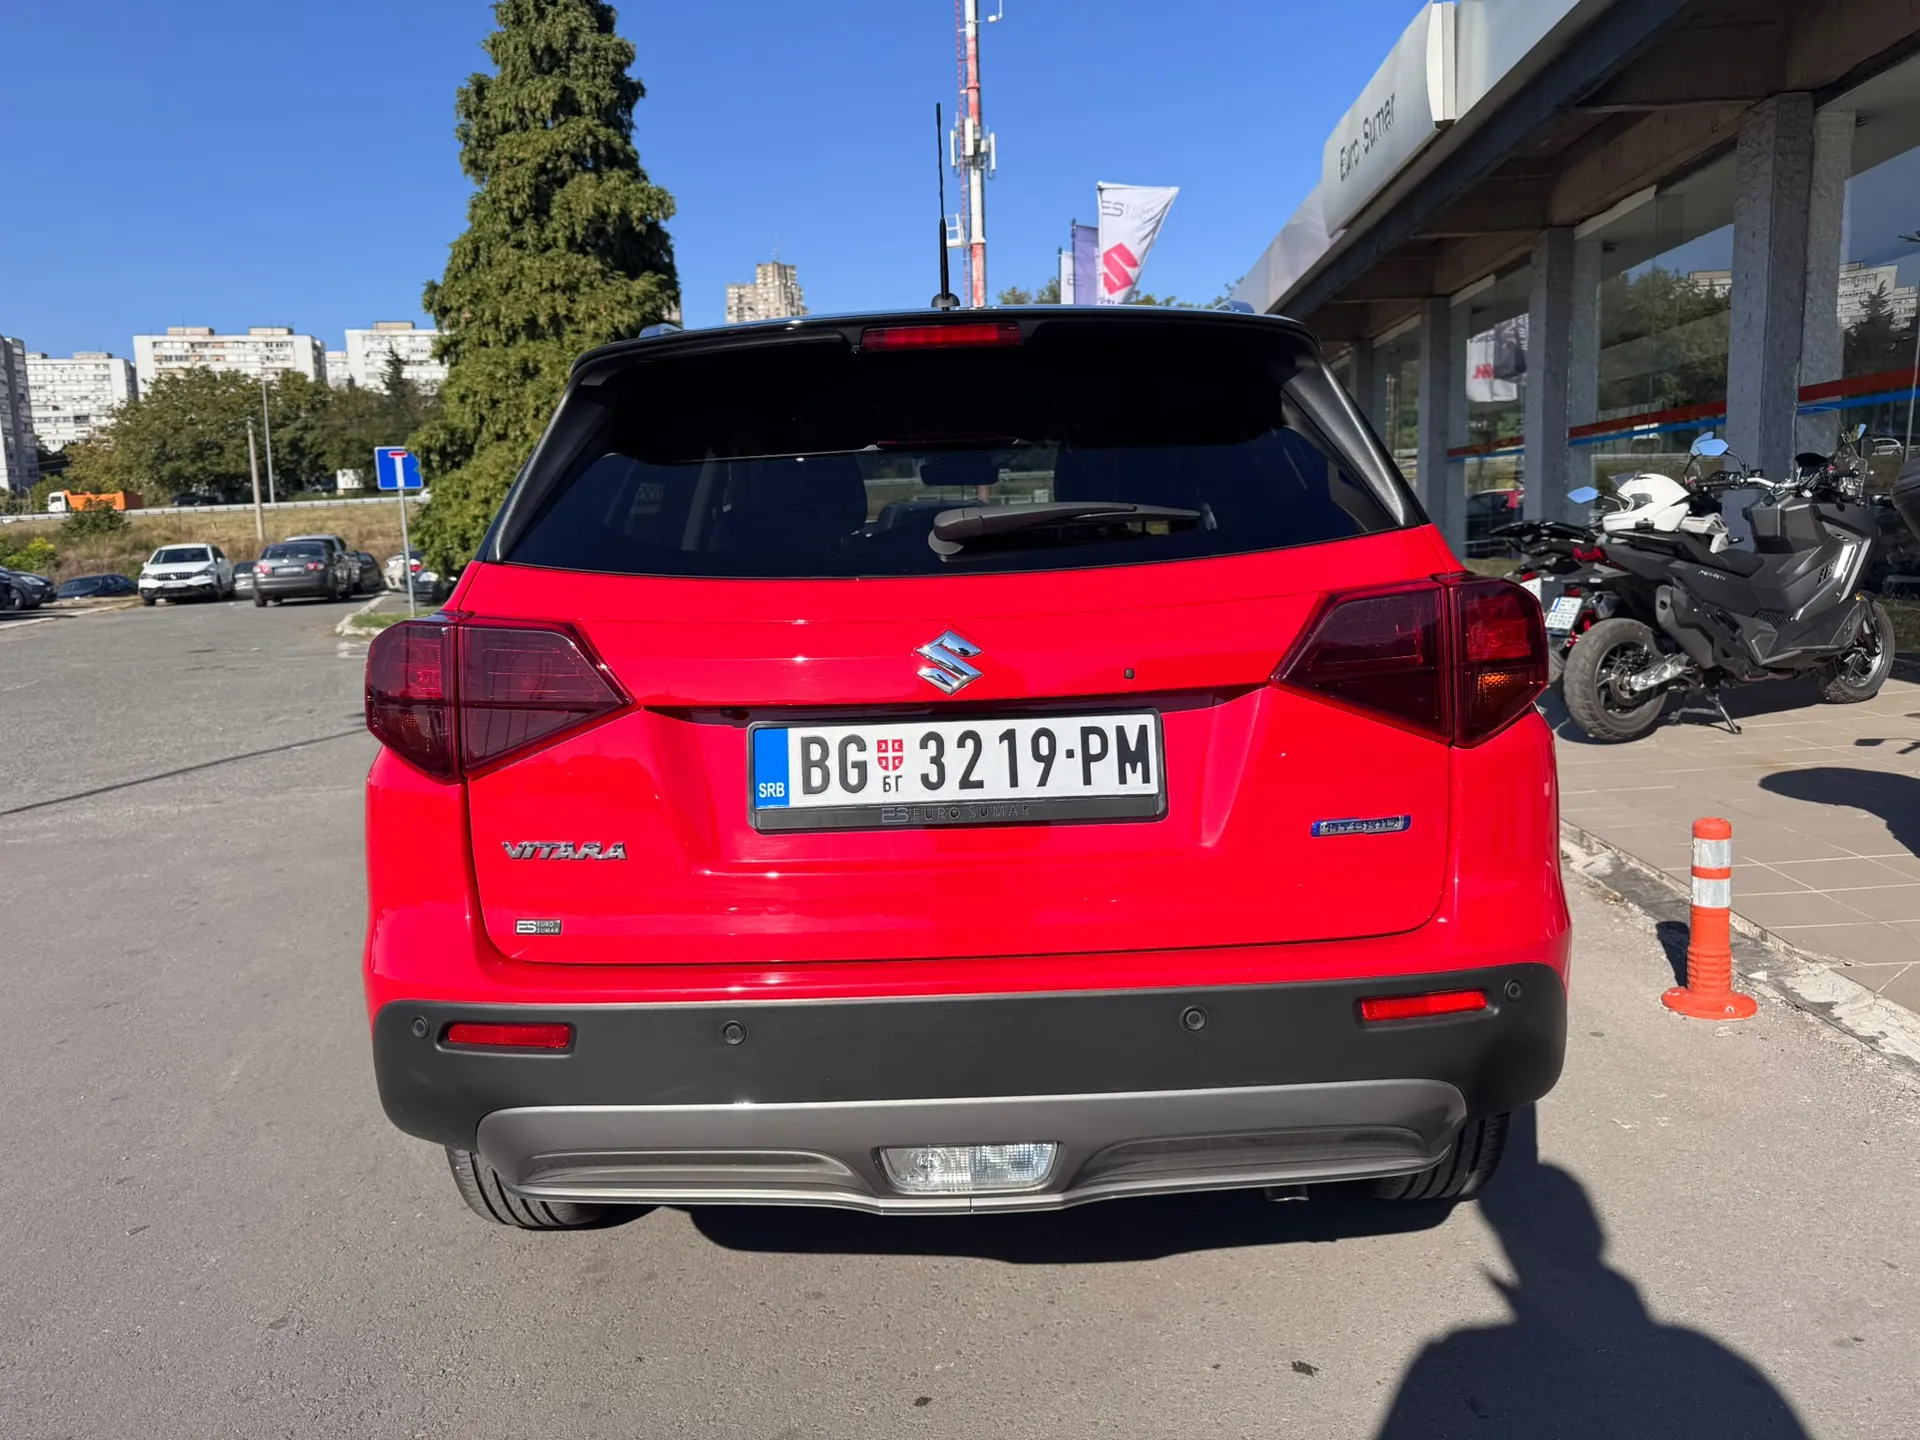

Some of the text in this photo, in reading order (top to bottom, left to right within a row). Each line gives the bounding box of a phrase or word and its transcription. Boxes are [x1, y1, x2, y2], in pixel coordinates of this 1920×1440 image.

[1362, 92, 1396, 154] Sumar
[800, 733, 868, 795] BG
[758, 782, 786, 798] SRB
[913, 807, 961, 821] EURO
[968, 804, 1031, 819] SUMAR
[502, 841, 627, 861] VITARA
